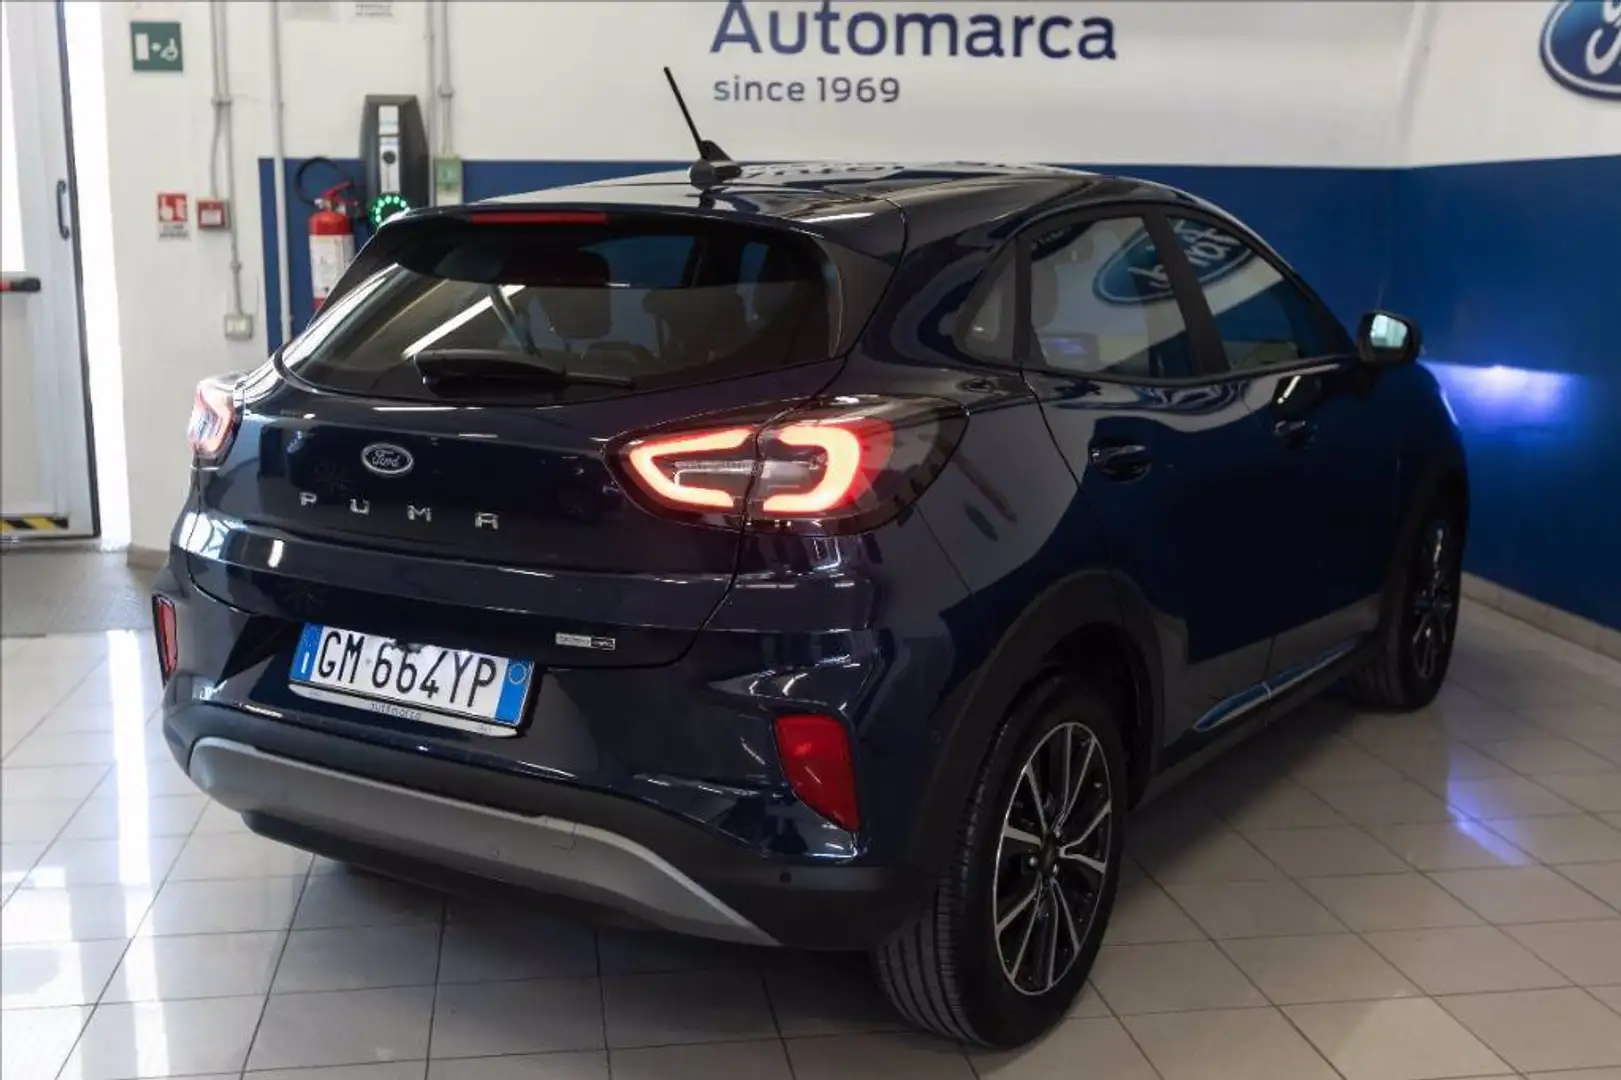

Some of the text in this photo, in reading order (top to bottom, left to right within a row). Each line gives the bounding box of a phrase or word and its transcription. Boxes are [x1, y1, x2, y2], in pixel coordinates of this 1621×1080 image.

[709, 1, 1117, 60] Automarca
[713, 75, 900, 104] since 1969
[300, 492, 499, 530] PUMA
[317, 630, 366, 684] GM
